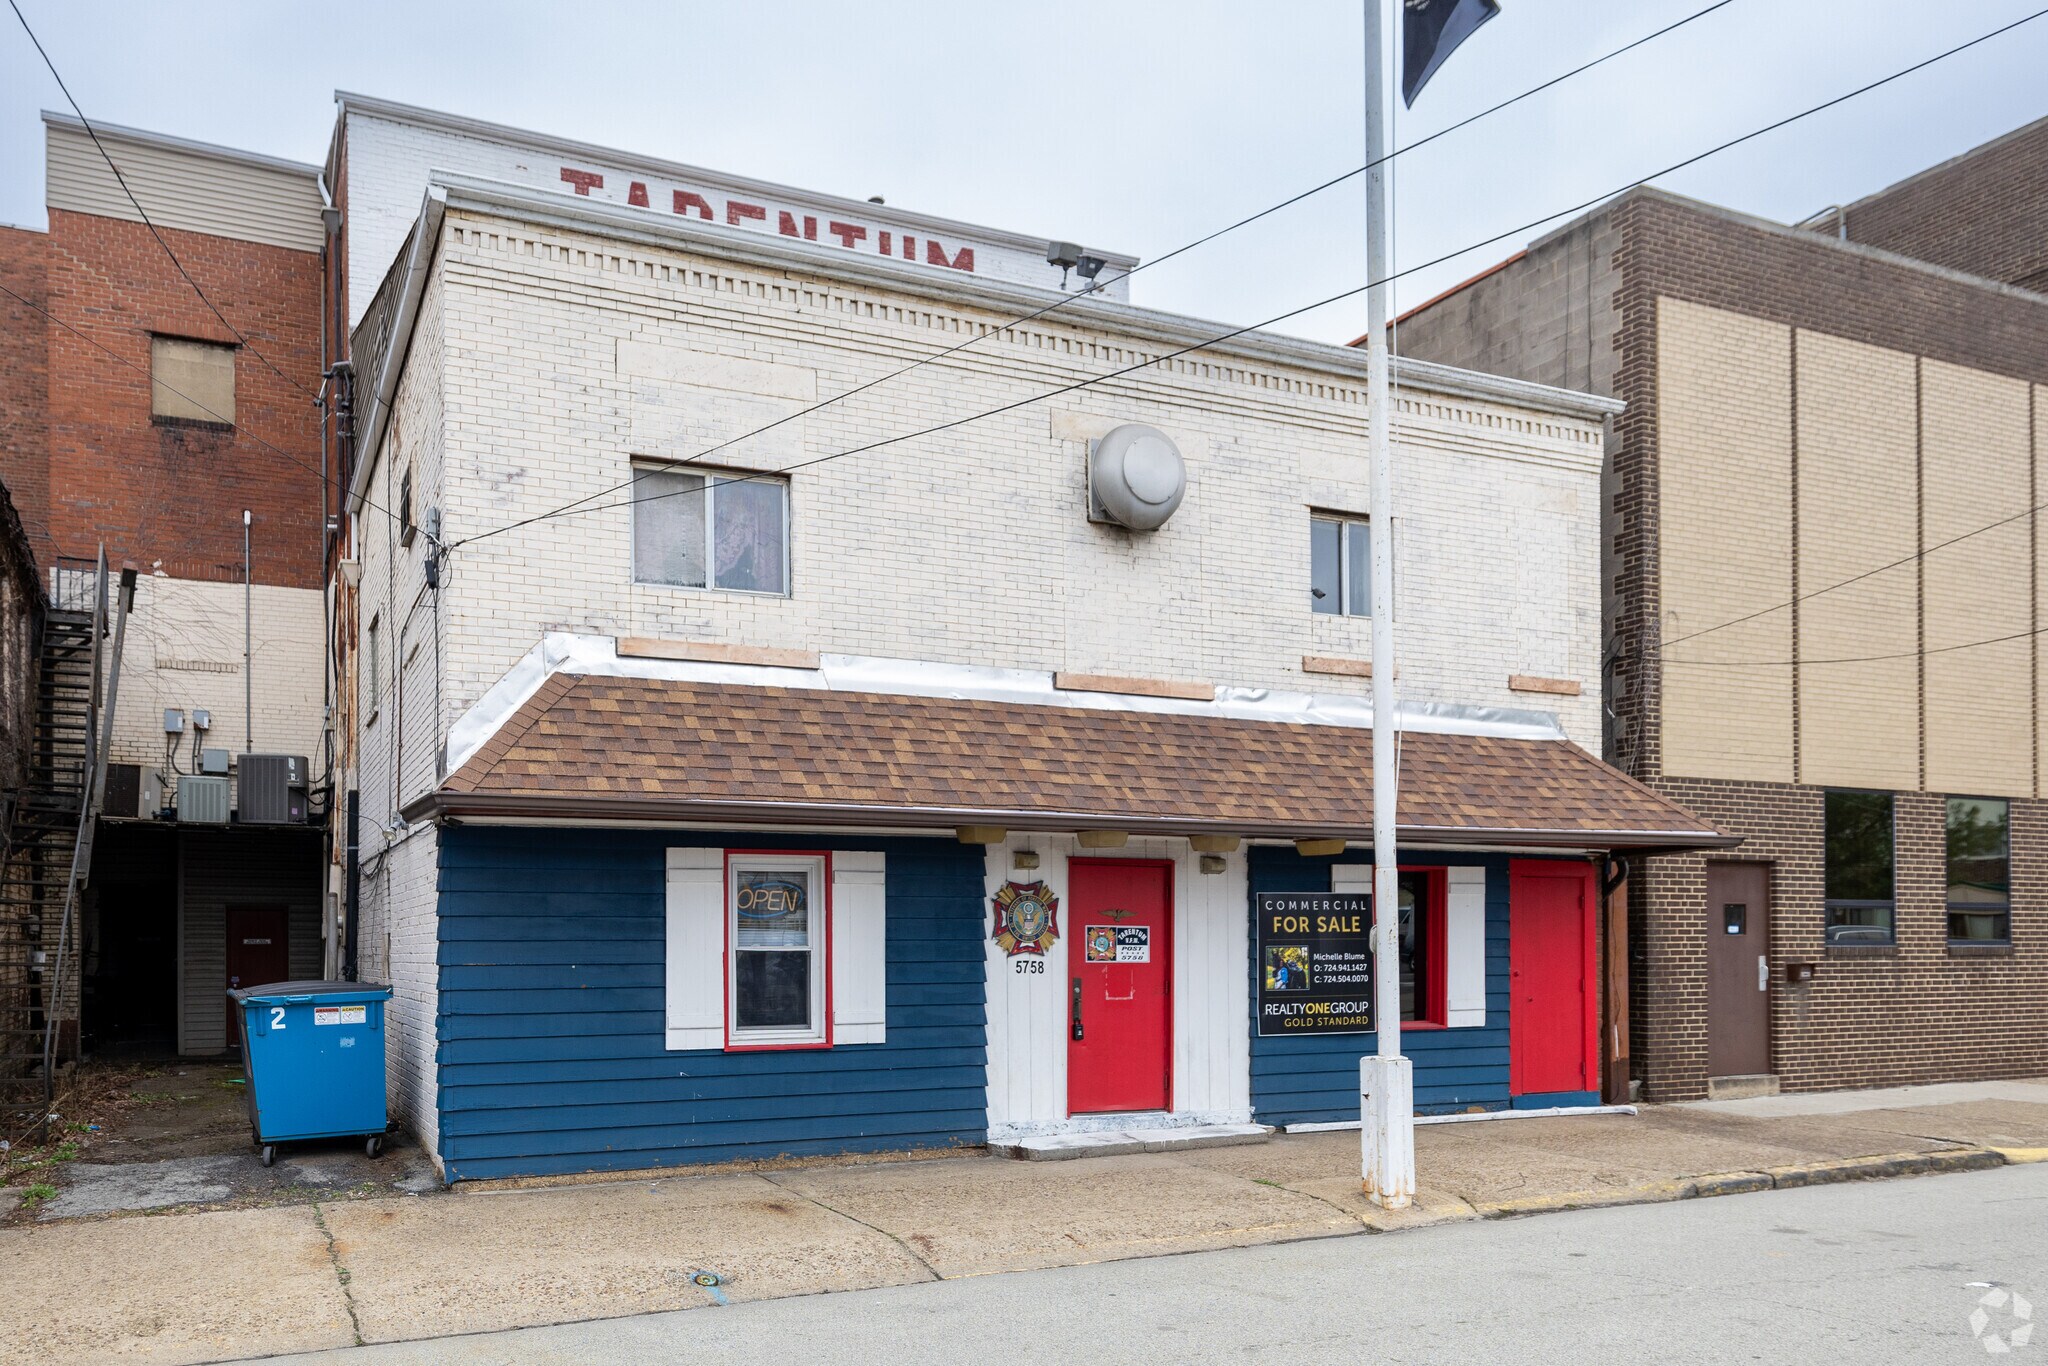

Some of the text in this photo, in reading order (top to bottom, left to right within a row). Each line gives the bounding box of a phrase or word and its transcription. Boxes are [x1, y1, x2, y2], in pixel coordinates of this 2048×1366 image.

[737, 888, 798, 911] OPEN
[1265, 900, 1366, 911] COMMERCIAL
[1273, 916, 1361, 933] FOR SALE
[1015, 960, 1045, 974] 5758
[1323, 963, 1367, 971] 724.941.1427
[1314, 974, 1369, 983] C: 724.504.0070
[270, 1007, 286, 1030] 2
[1284, 1016, 1369, 1027] GOLD STANDARD
